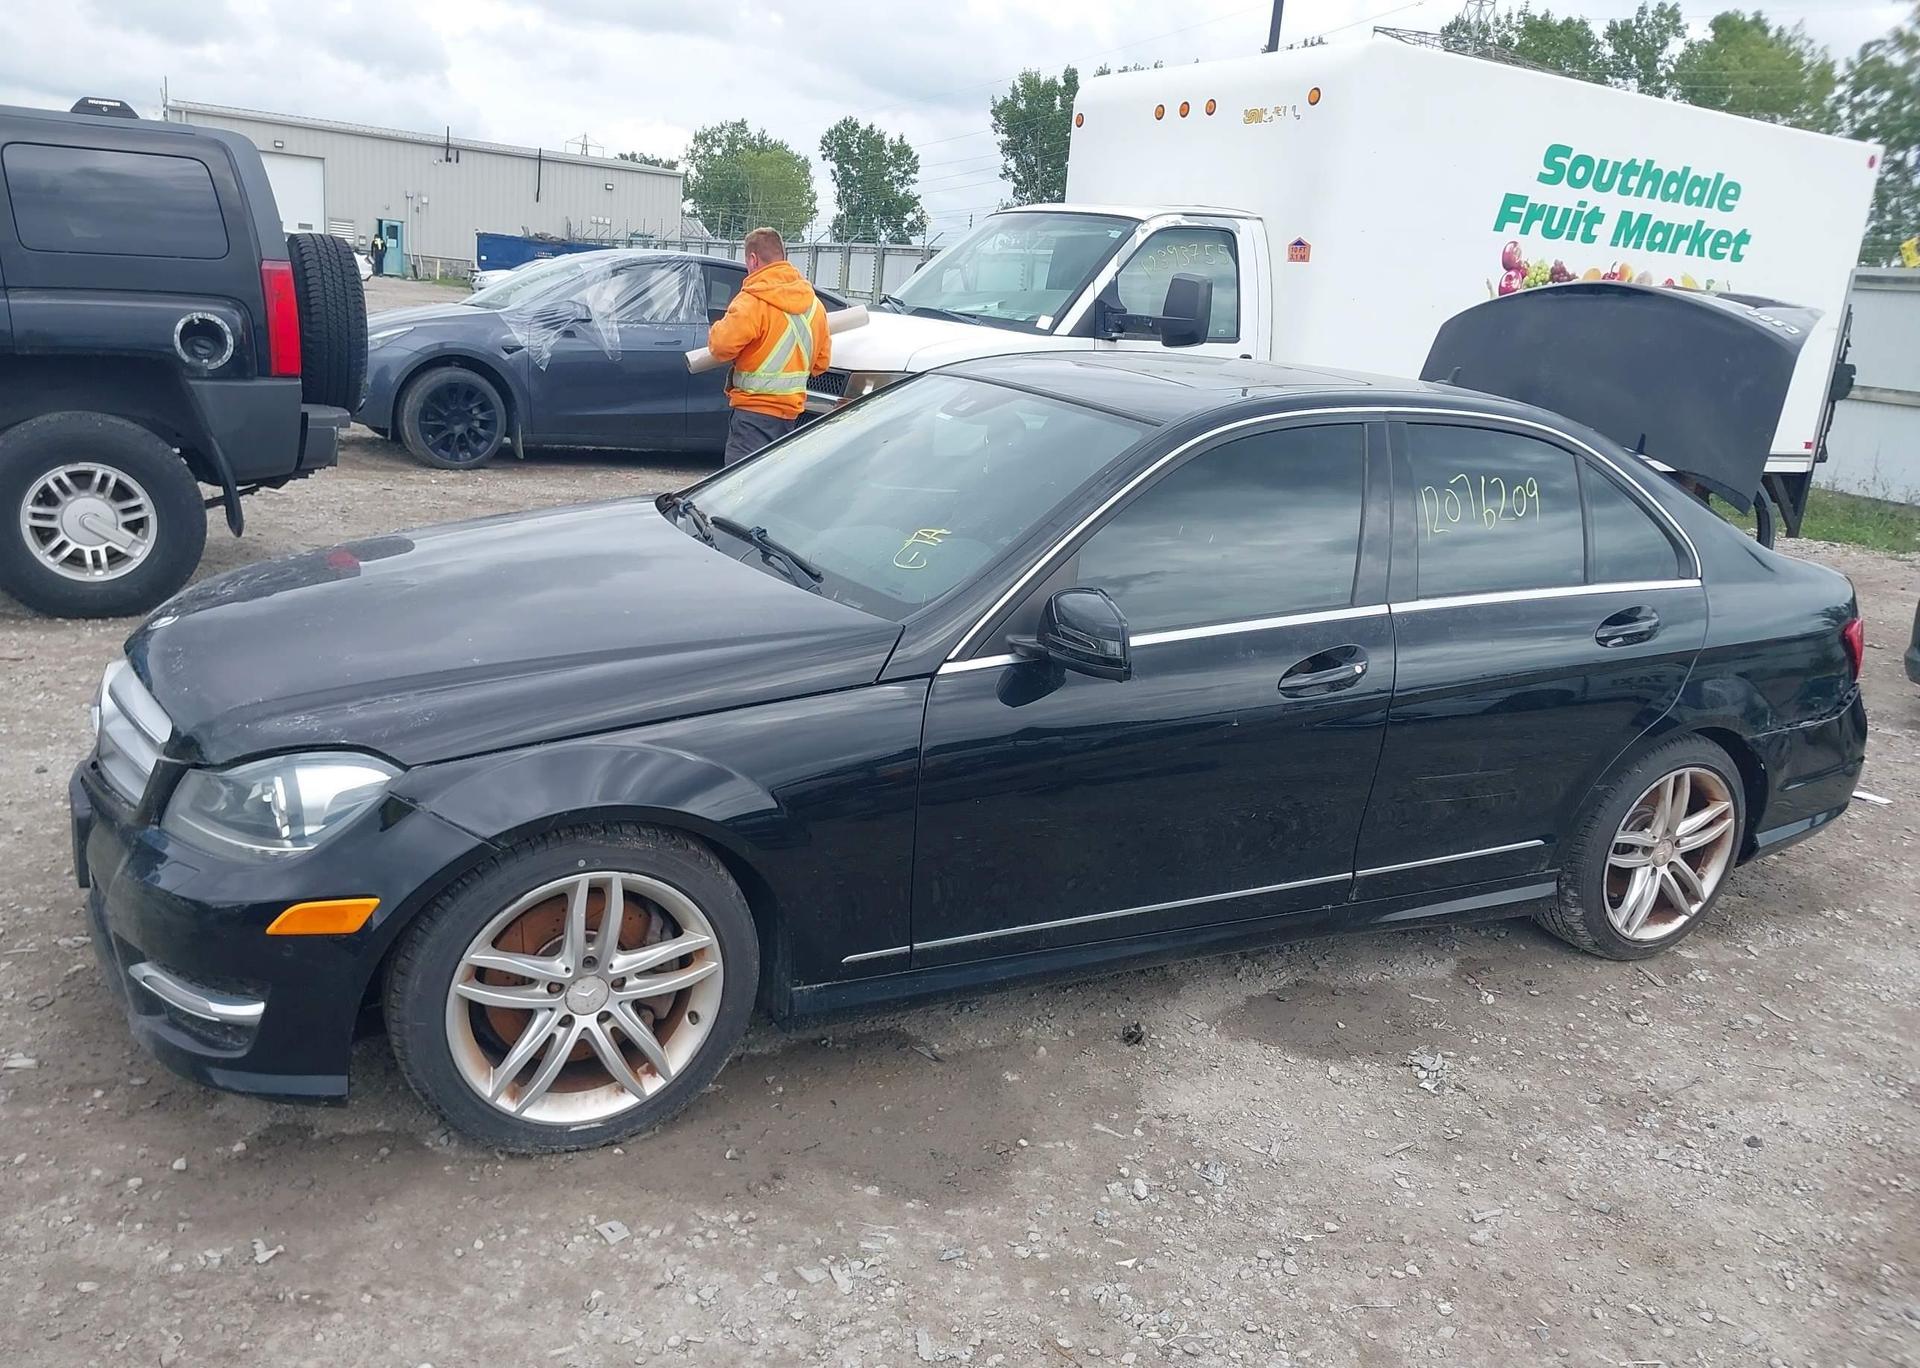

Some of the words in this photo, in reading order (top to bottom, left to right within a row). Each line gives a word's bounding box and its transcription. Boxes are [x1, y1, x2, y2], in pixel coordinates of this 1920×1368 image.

[1537, 143, 1742, 212] Southdale
[1493, 192, 1606, 244] Fruit
[1610, 210, 1752, 263] Market
[1420, 473, 1540, 543] 12076209
